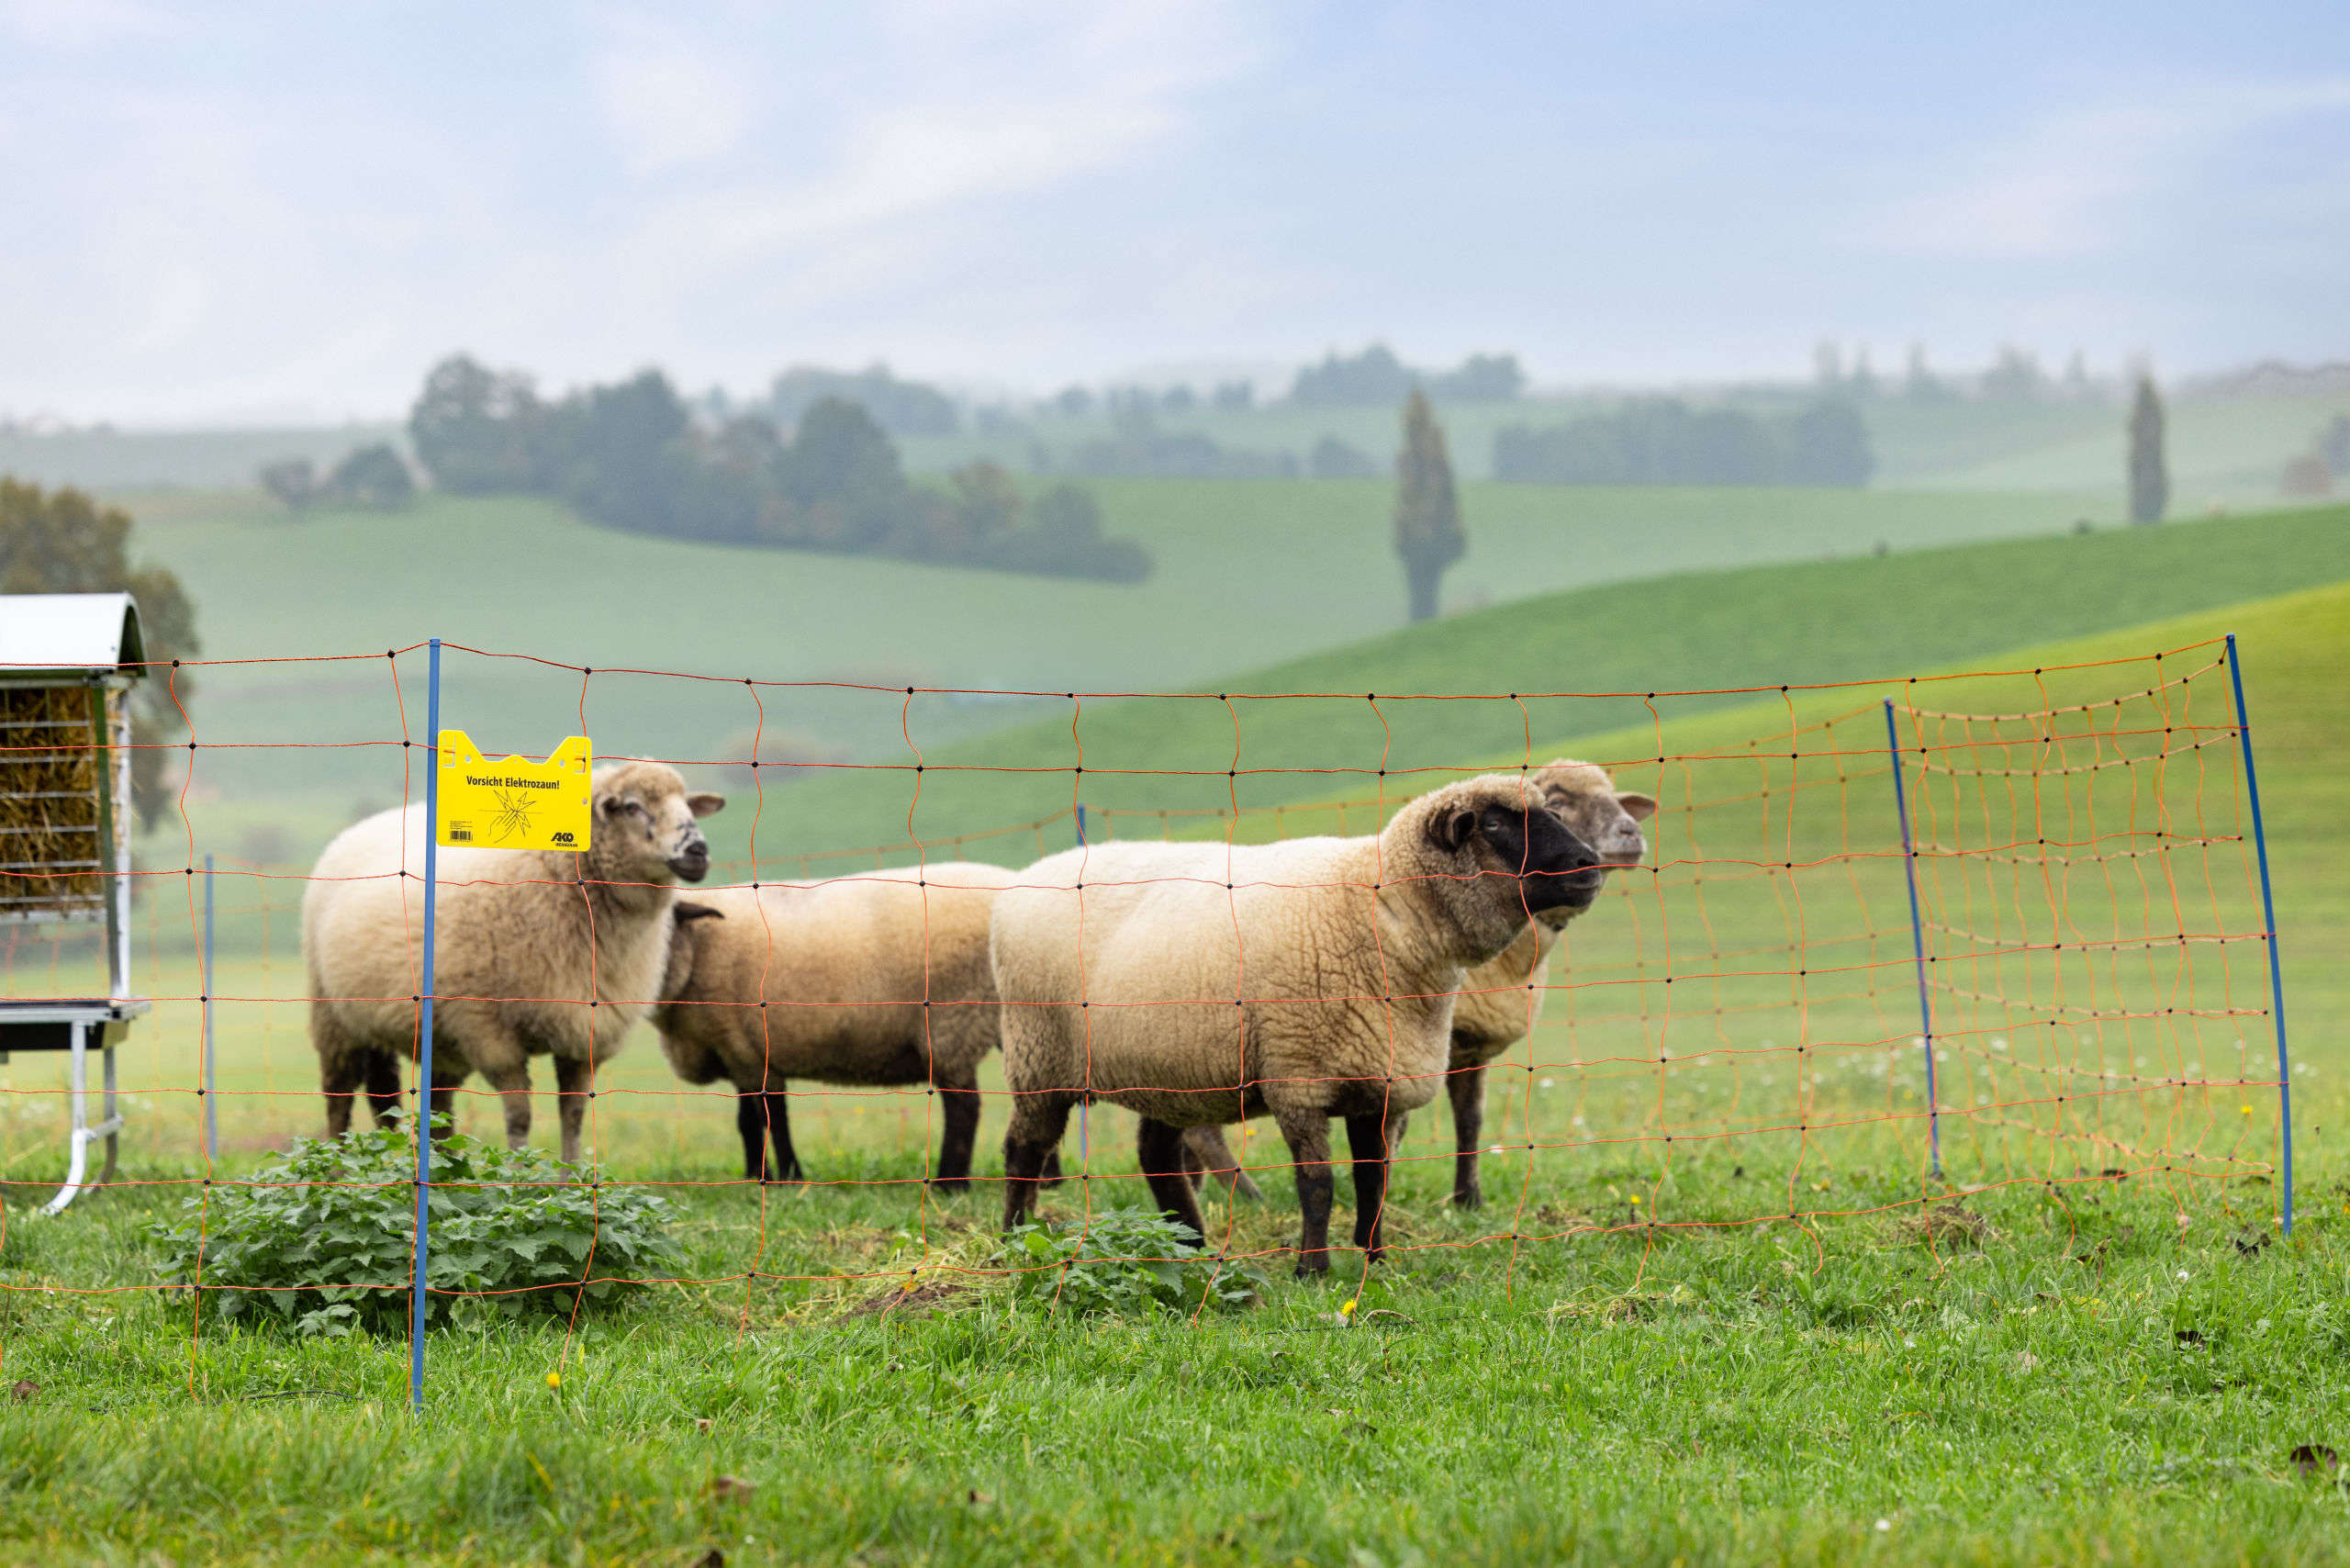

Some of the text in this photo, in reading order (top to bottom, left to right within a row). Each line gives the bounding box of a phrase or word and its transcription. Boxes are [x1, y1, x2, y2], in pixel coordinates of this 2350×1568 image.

[466, 776, 560, 790] Vorsicht Elektrozaun!
[551, 832, 575, 842] AKO
